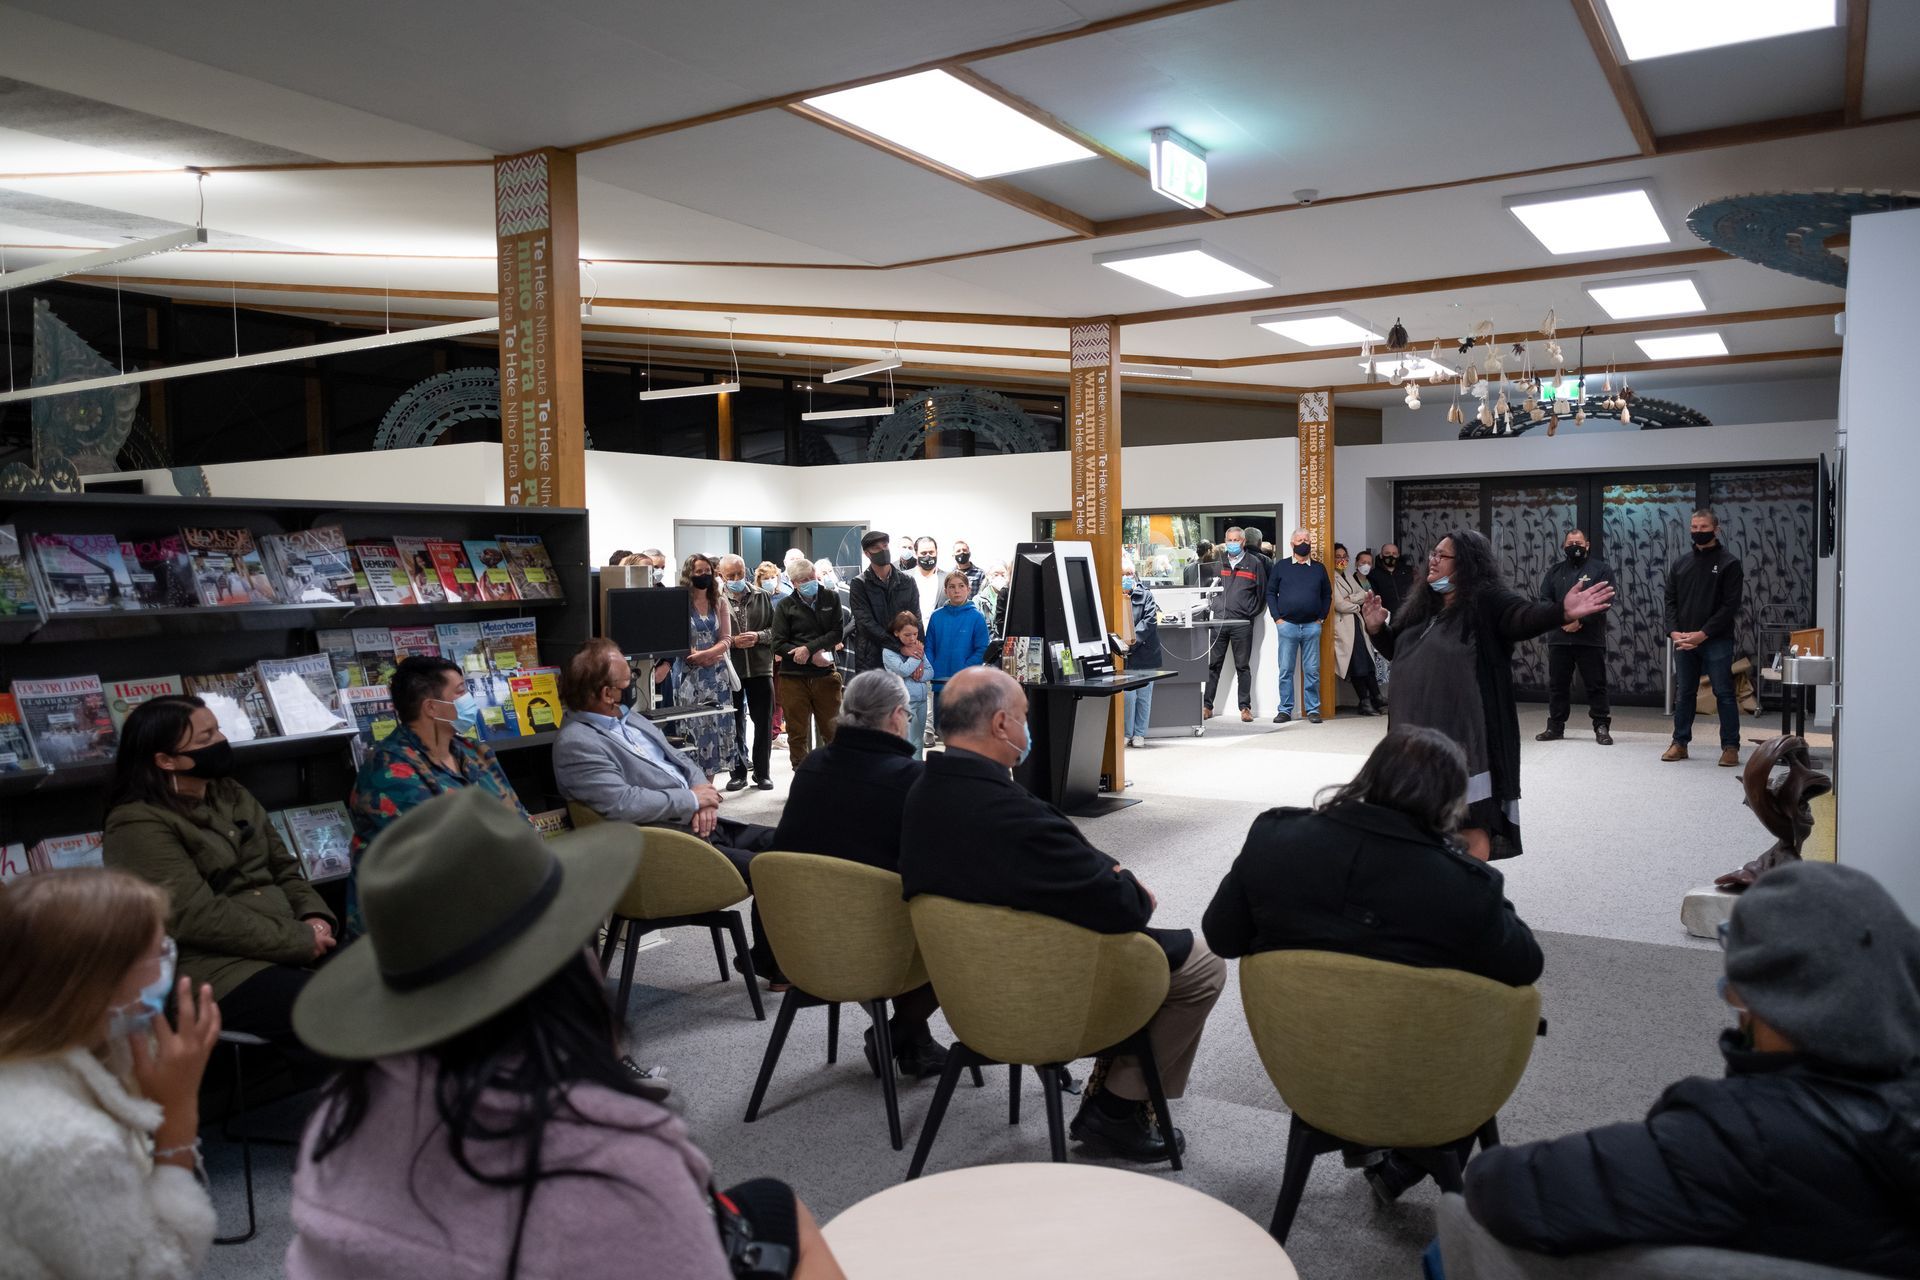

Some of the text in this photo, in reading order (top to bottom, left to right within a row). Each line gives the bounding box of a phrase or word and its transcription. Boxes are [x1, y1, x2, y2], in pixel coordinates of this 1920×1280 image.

[534, 236, 547, 260] Te
[535, 265, 548, 310] Heke
[536, 315, 549, 354] Niho
[503, 243, 522, 505] Niho Puta Te Heke Niho Puta Te
[538, 399, 551, 422] Te
[1319, 424, 1326, 434] Te
[539, 427, 552, 471] Heke
[1075, 372, 1085, 535] Whirinui Te Heke Whirinui Te Heke
[1098, 370, 1108, 535] Te Heke Whirinui Te Heke Whirinui
[1301, 465, 1308, 475] Te
[1319, 495, 1326, 505] Te
[363, 560, 398, 568] DEMENTIA
[438, 624, 459, 636] Life
[482, 620, 534, 631] Motorhomes
[64, 679, 99, 692] LIVING
[113, 682, 173, 698] Haven
